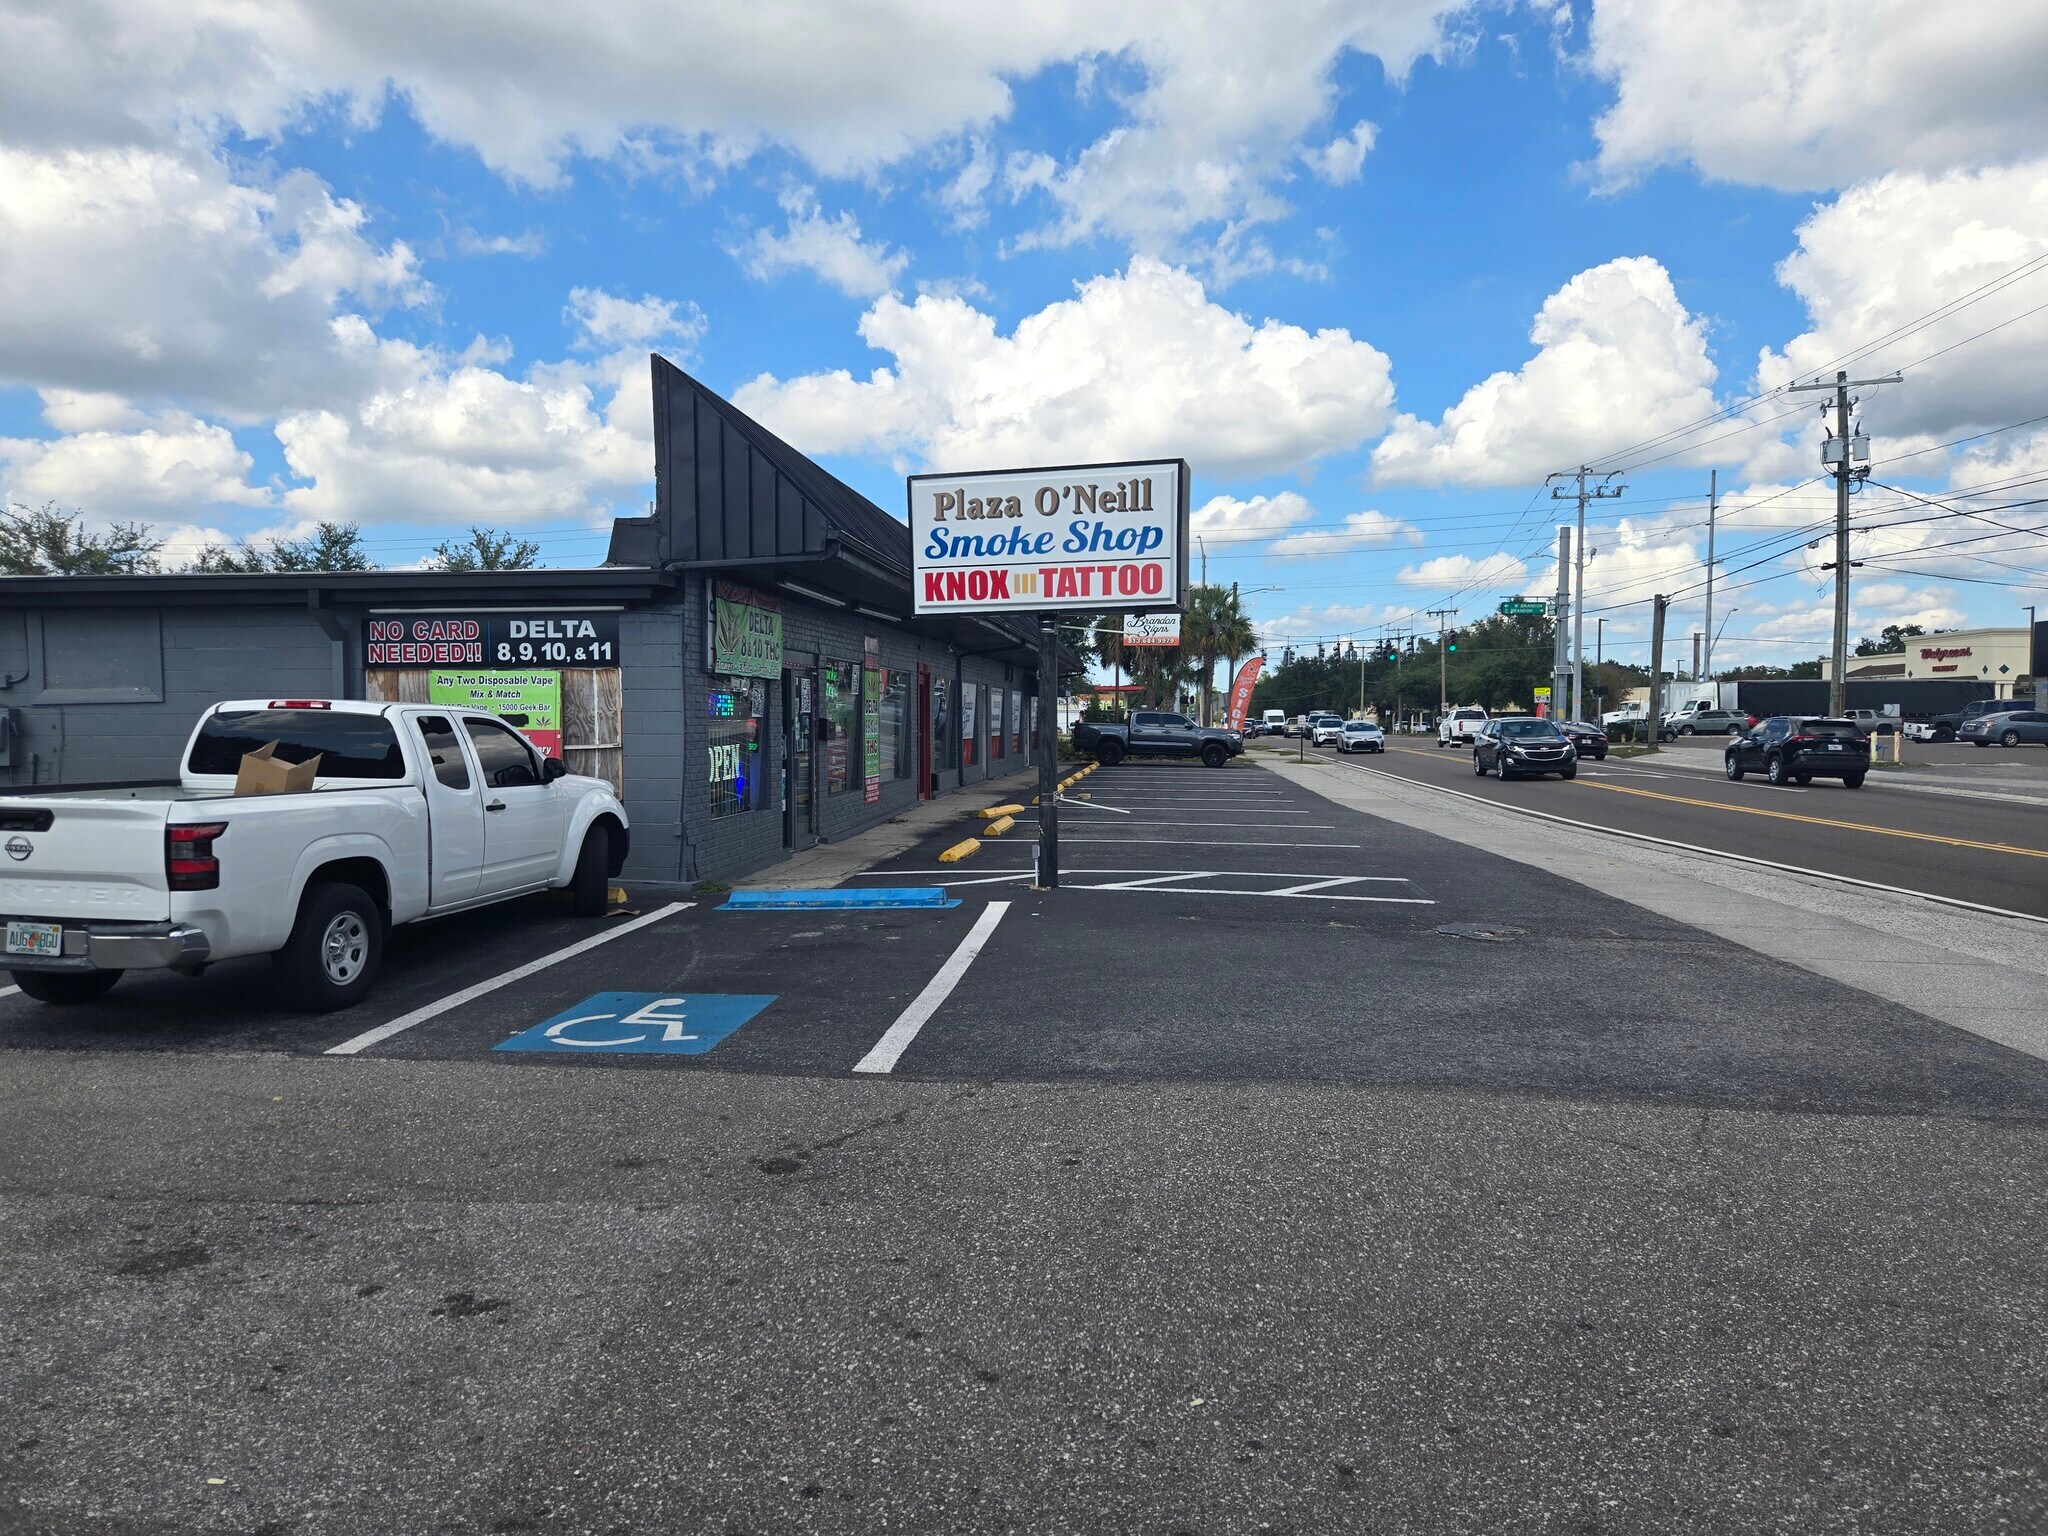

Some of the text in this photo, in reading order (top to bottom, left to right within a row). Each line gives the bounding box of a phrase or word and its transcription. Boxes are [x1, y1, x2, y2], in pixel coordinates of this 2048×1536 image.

[933, 478, 1153, 522] Plaza O'Neill
[924, 520, 1164, 560] Smoke Shop
[924, 563, 1163, 602] KNOX TATTOO
[369, 620, 480, 640] NO CARD
[510, 620, 597, 638] DELTA
[749, 611, 774, 637] DELTA
[1127, 614, 1176, 628] Brandon
[1137, 625, 1169, 637] Signs
[368, 643, 482, 663] NEEDED!!
[497, 643, 515, 662] 8,
[519, 643, 537, 662] 9,
[541, 643, 572, 662] 10,
[740, 635, 747, 658] 8
[753, 639, 763, 660] 10
[764, 640, 780, 662] THC
[1920, 647, 1972, 662] Walgreens
[437, 675, 554, 687] Any Two Disposable Vape
[470, 690, 521, 698] Mix & Match
[5, 844, 33, 852] NISSAN
